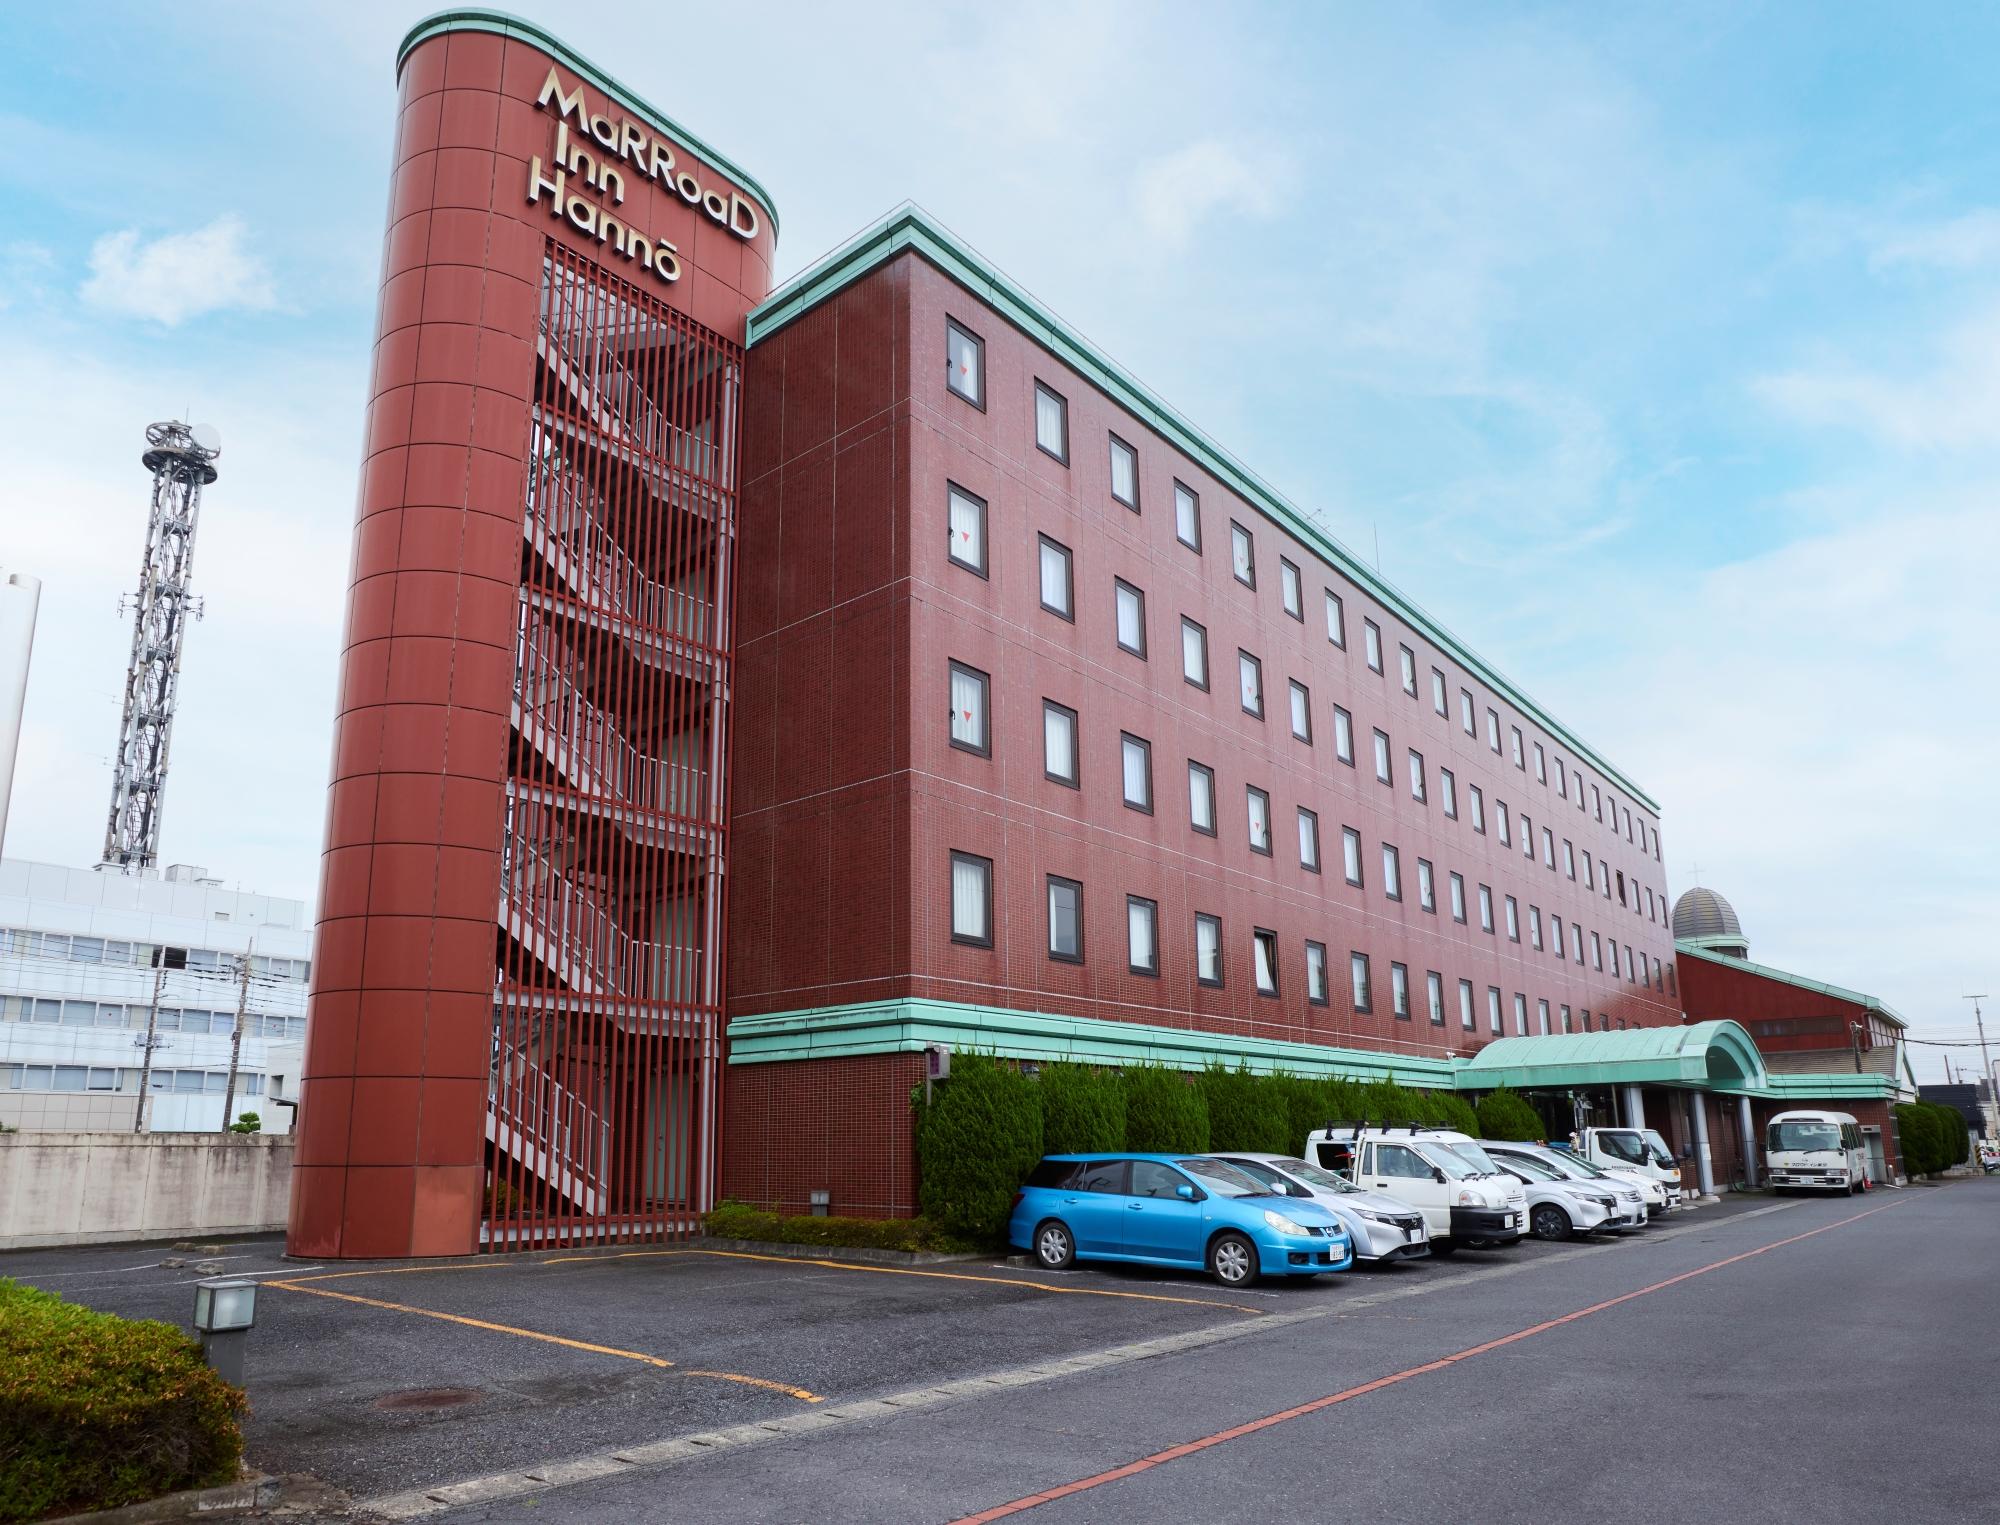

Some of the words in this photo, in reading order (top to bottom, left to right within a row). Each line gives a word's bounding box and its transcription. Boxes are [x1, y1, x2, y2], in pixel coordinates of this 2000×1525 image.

[535, 66, 760, 239] MaRRoaD
[553, 120, 625, 206] Inn
[527, 154, 682, 283] Hannō
